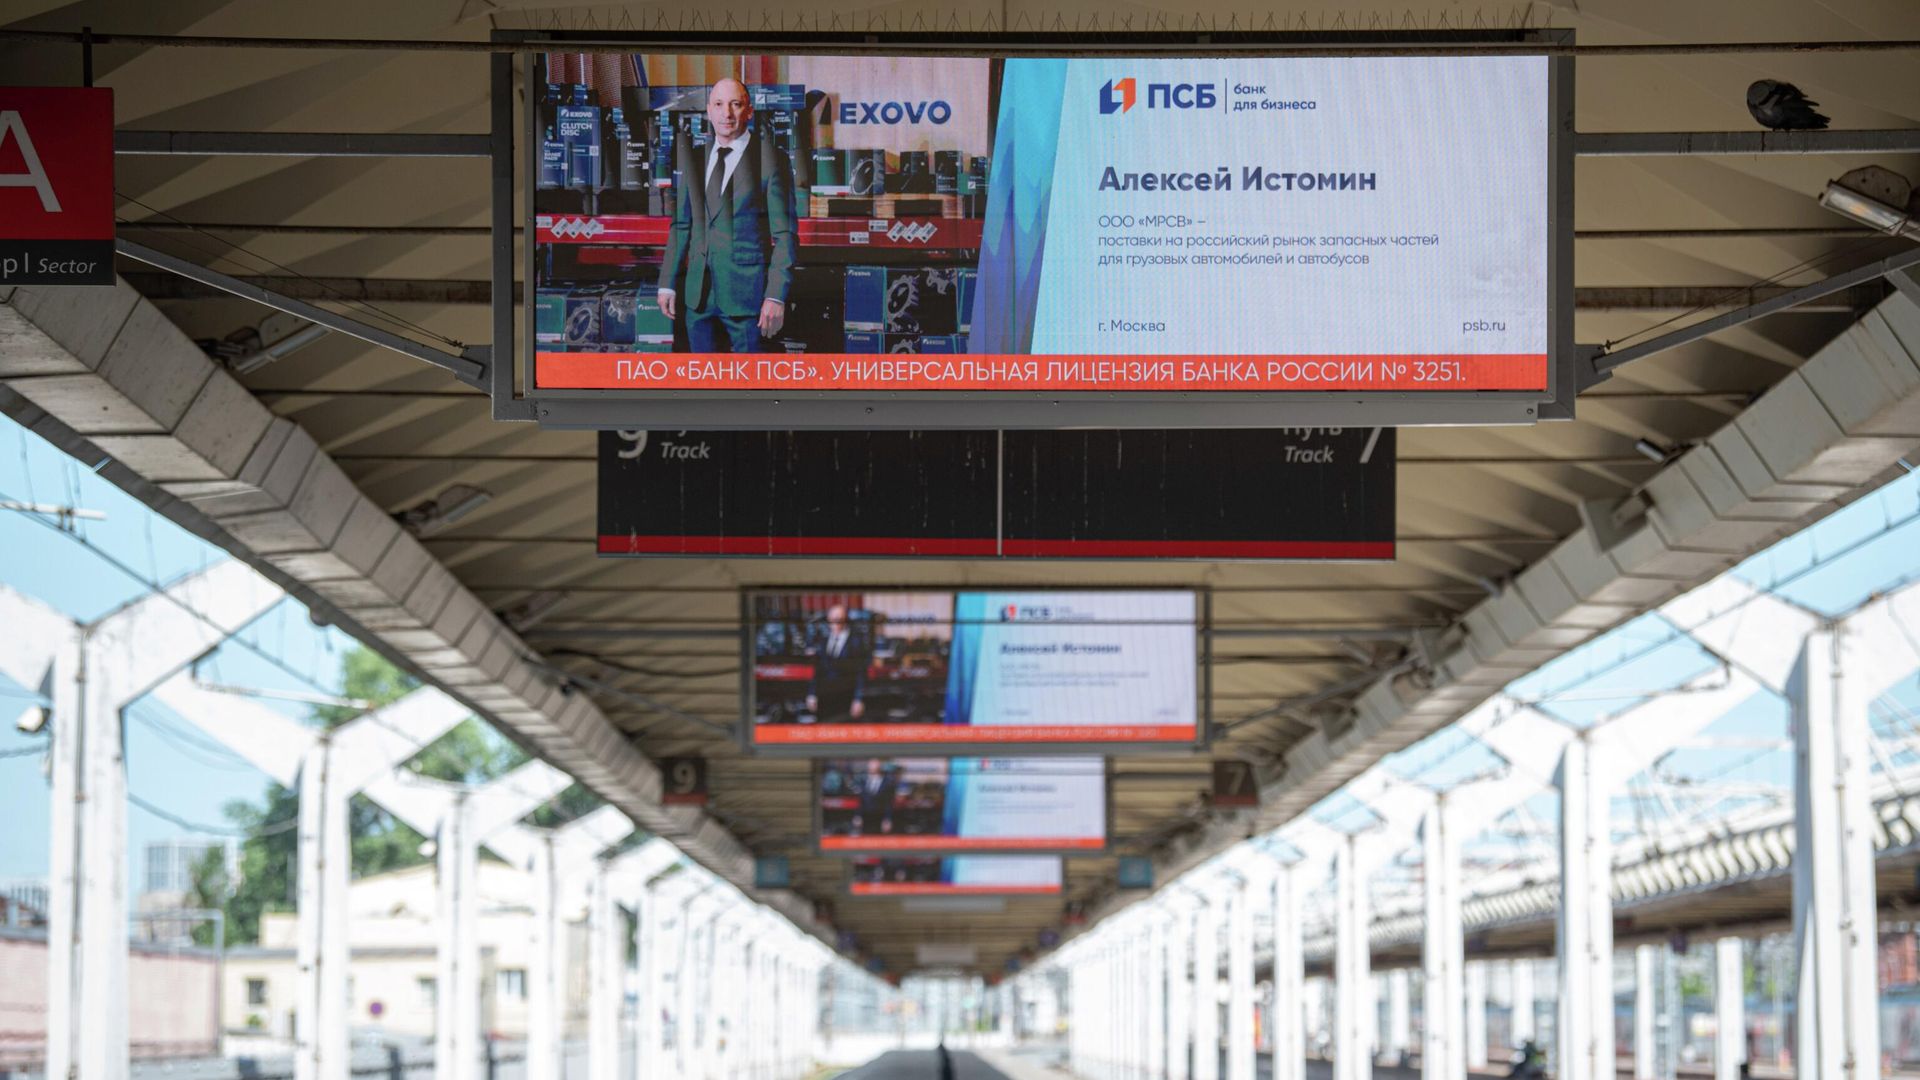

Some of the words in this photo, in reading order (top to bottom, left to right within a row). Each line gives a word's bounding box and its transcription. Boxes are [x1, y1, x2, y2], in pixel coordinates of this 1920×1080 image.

[1148, 83, 1216, 109] ПСБ
[1233, 83, 1267, 95] банк
[840, 100, 952, 125] EXOVO
[1233, 101, 1257, 112] для
[1260, 98, 1317, 110] бизнеса
[560, 122, 593, 130] CLUTCH
[1098, 166, 1232, 192] Алексей
[1242, 167, 1377, 191] Истомин
[1098, 215, 1135, 228] ООО
[1138, 215, 1193, 228] «МРСВ»
[1098, 236, 1162, 247] поставки
[1165, 236, 1183, 247] на
[1186, 234, 1269, 249] российский
[1272, 236, 1316, 248] рынок
[1319, 235, 1387, 247] запасных
[1390, 234, 1439, 246] частей
[37, 258, 97, 274] Sector
[1098, 255, 1123, 267] для
[1126, 255, 1188, 268] грузовых
[1191, 252, 1283, 265] автомобилей
[1286, 255, 1295, 265] и
[1298, 252, 1370, 268] автобусов
[1098, 322, 1107, 332] г.
[1110, 319, 1166, 332] Москва
[1462, 319, 1506, 334] psb.ru
[617, 360, 669, 380] ПАО
[676, 360, 749, 381] «БАНК
[757, 360, 823, 381] ПСБ».
[831, 360, 1038, 381] УНИВЕРСАЛЬНАЯ
[1045, 361, 1174, 384] ЛИЦЕНЗИЯ
[1182, 361, 1260, 382] БАНКА
[1267, 361, 1373, 382] РОССИИ
[1381, 361, 1407, 381] №
[1413, 361, 1466, 382] 3251.
[661, 441, 710, 459] Track
[1284, 445, 1334, 463] Track
[673, 762, 697, 794] 9
[1225, 763, 1247, 796] 7
